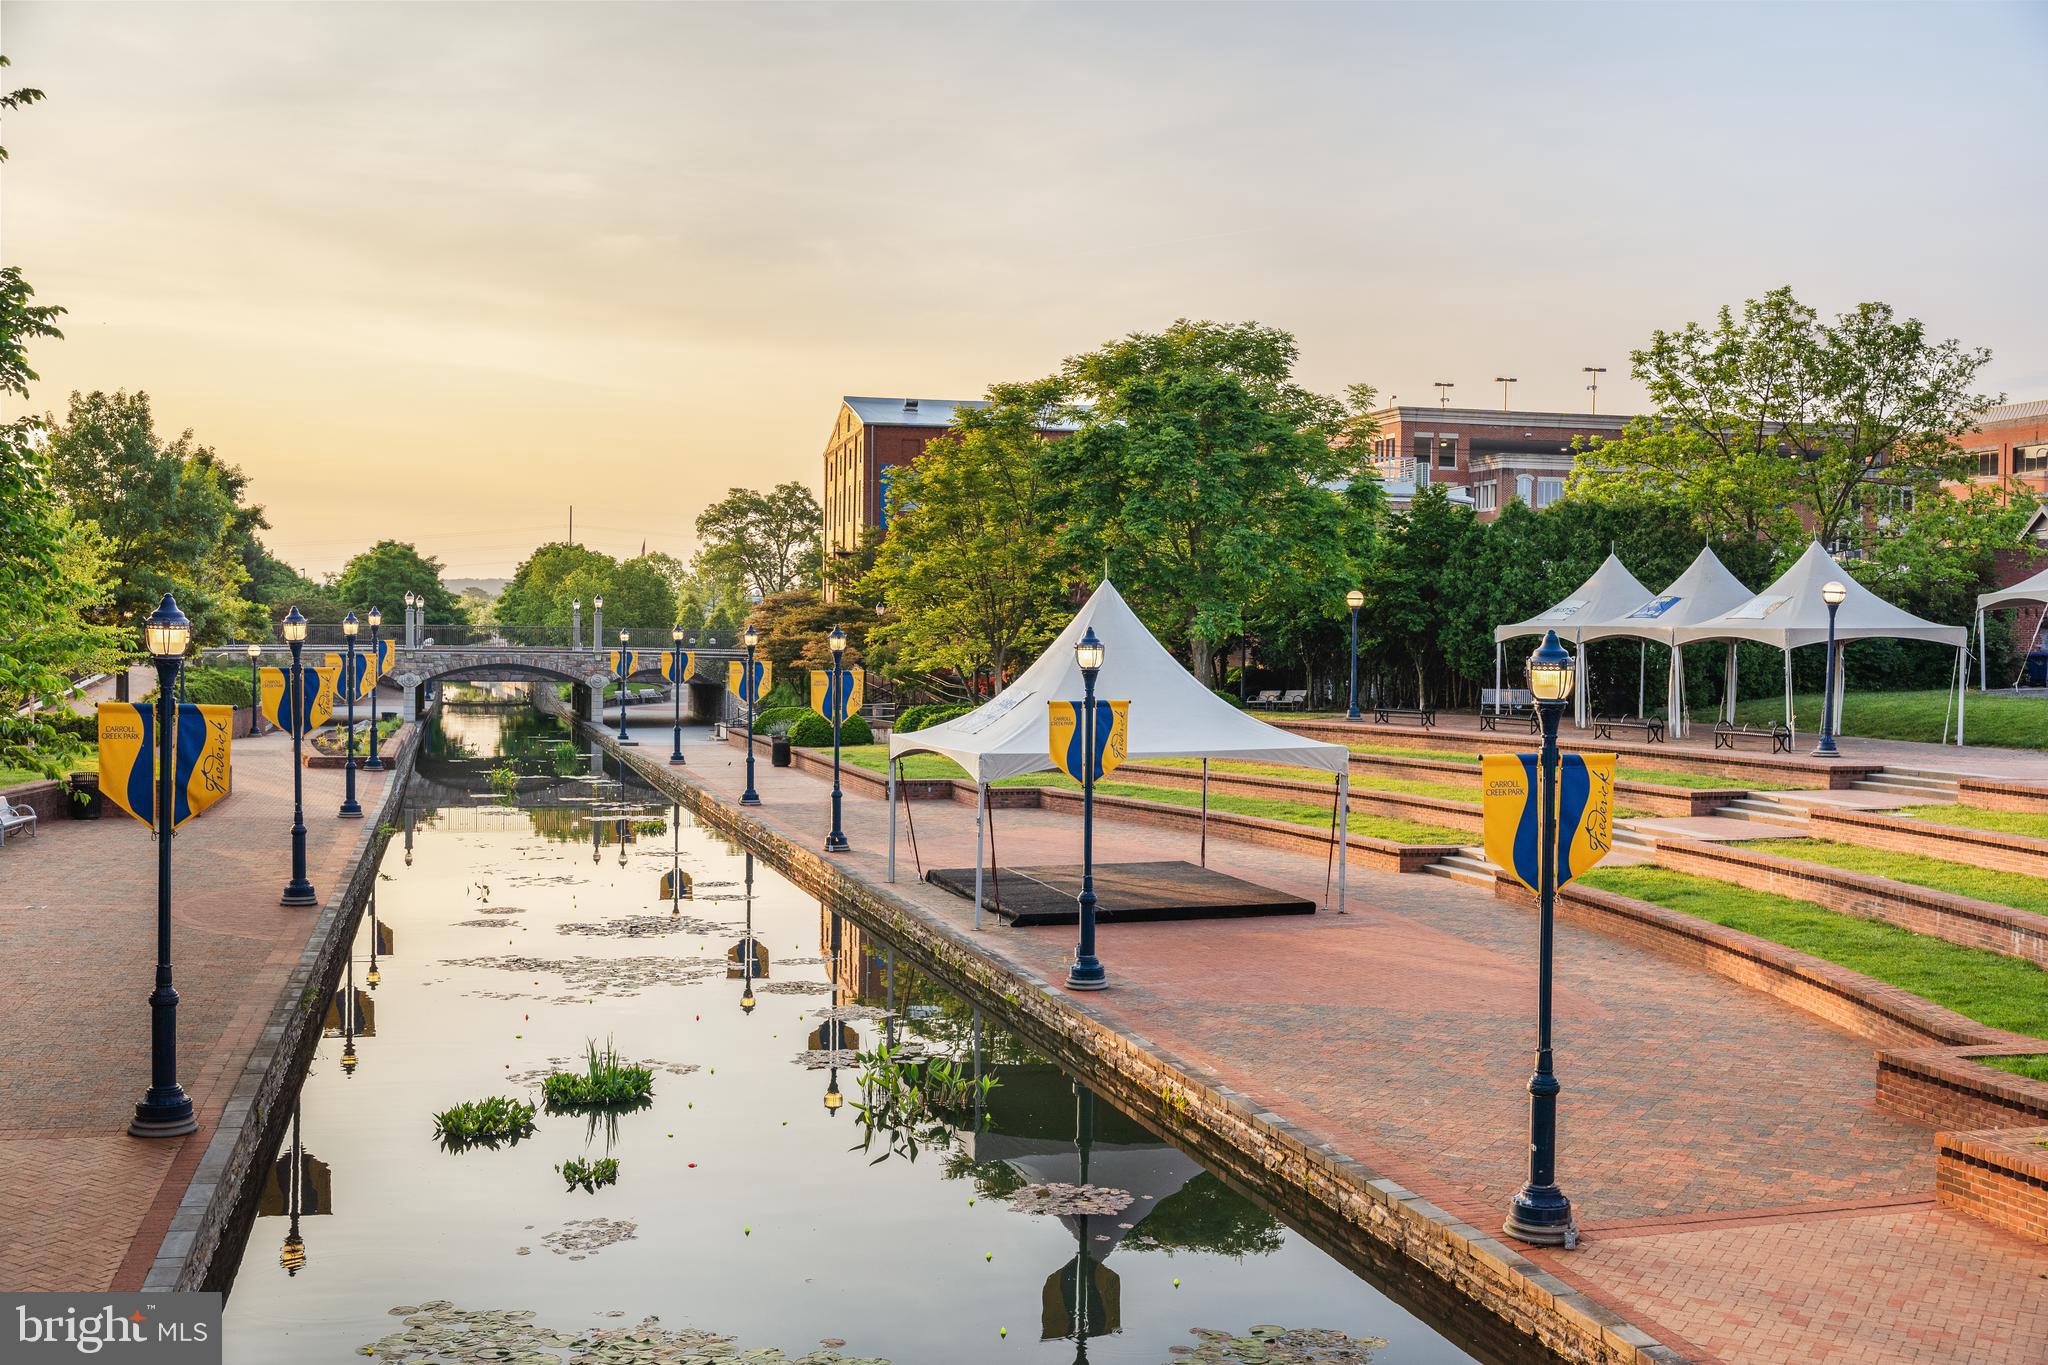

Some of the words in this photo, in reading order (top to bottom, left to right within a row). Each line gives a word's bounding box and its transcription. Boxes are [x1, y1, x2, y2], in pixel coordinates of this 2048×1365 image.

[105, 725, 135, 733] CARROLL
[101, 732, 122, 740] CREEK
[123, 732, 140, 740] PARK
[1110, 709, 1126, 760] Frederick
[201, 718, 228, 794] Frederick
[1490, 780, 1520, 789] CARROLL
[1507, 788, 1525, 796] PARK
[1585, 766, 1611, 854] Frederick
